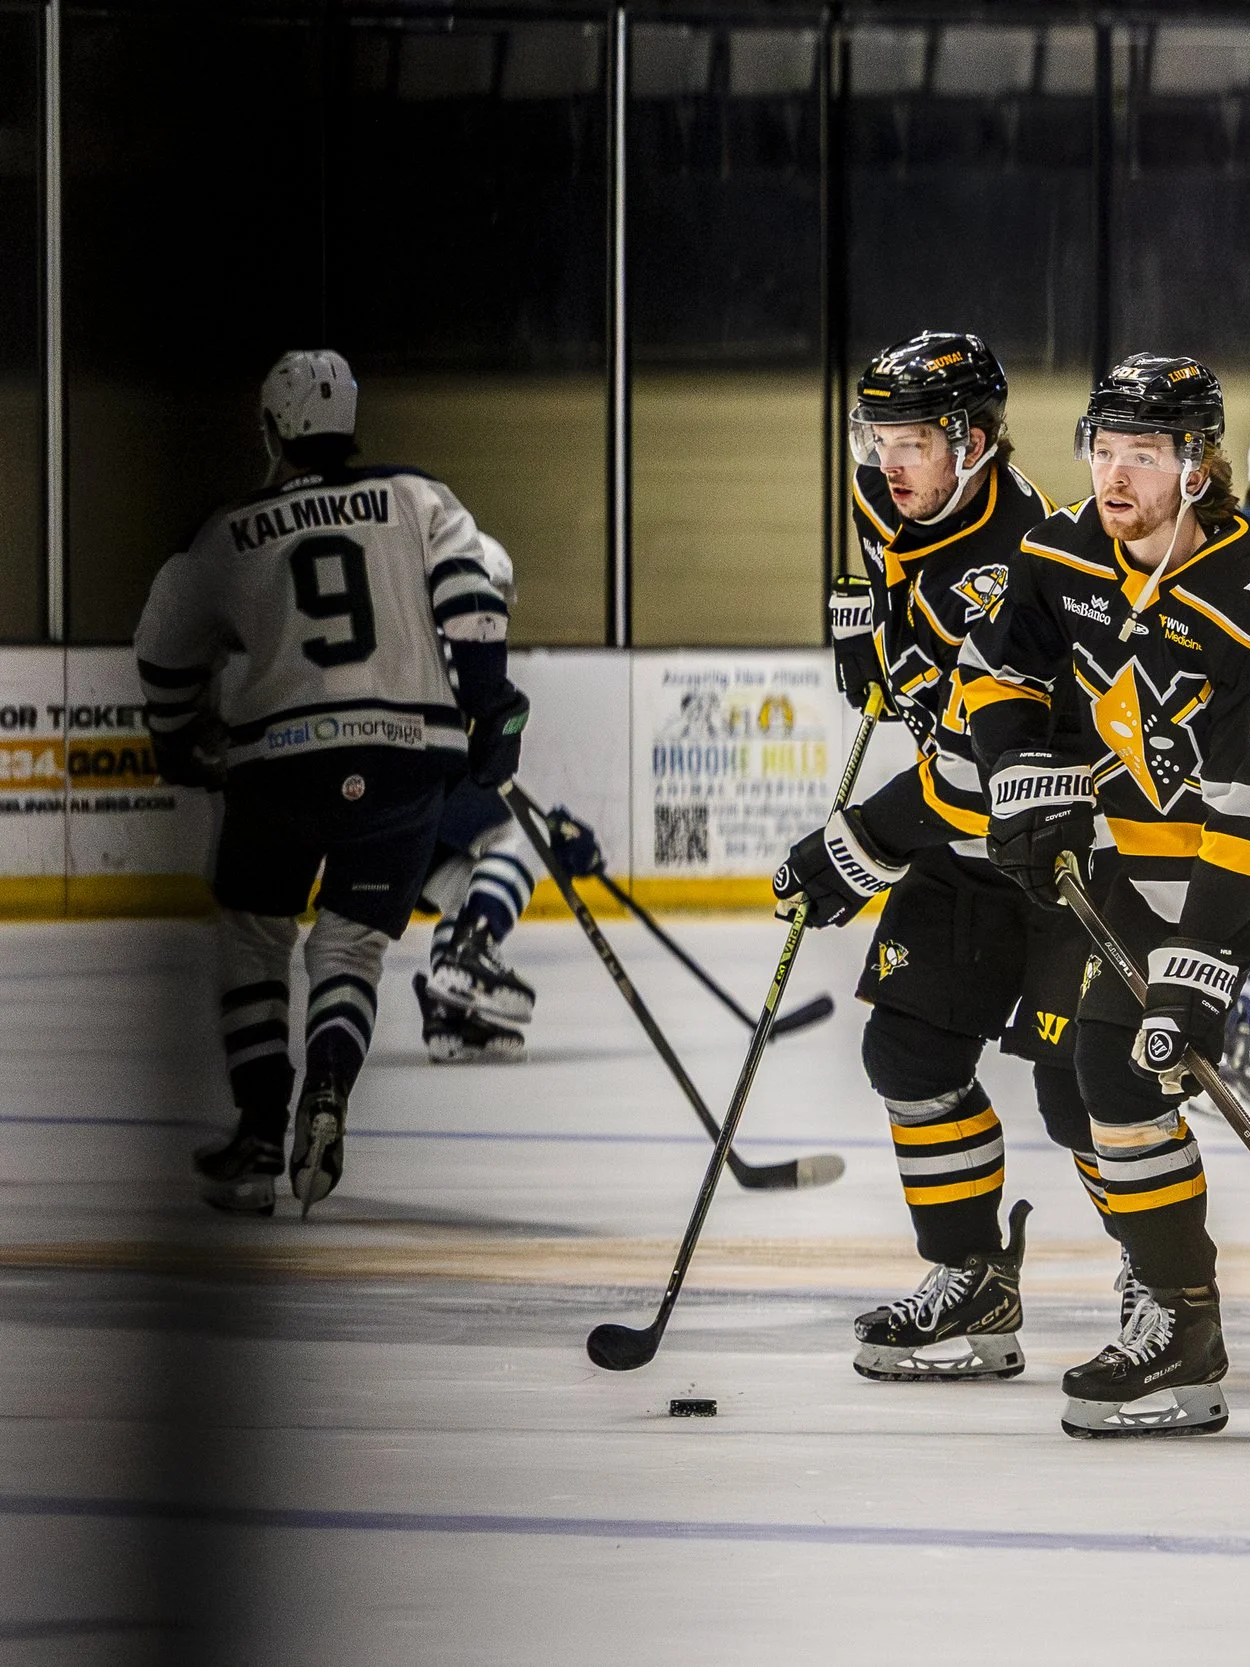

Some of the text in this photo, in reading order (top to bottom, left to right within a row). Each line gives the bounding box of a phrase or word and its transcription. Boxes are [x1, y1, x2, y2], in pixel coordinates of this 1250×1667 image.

[230, 489, 389, 551] KALMIKOV
[290, 535, 377, 668] 9
[1062, 596, 1111, 625] WesBanco
[1166, 618, 1189, 635] WVU
[942, 667, 971, 736] 1
[267, 721, 310, 748] total
[784, 909, 805, 956] ALPHA
[966, 1297, 1010, 1333] CCM
